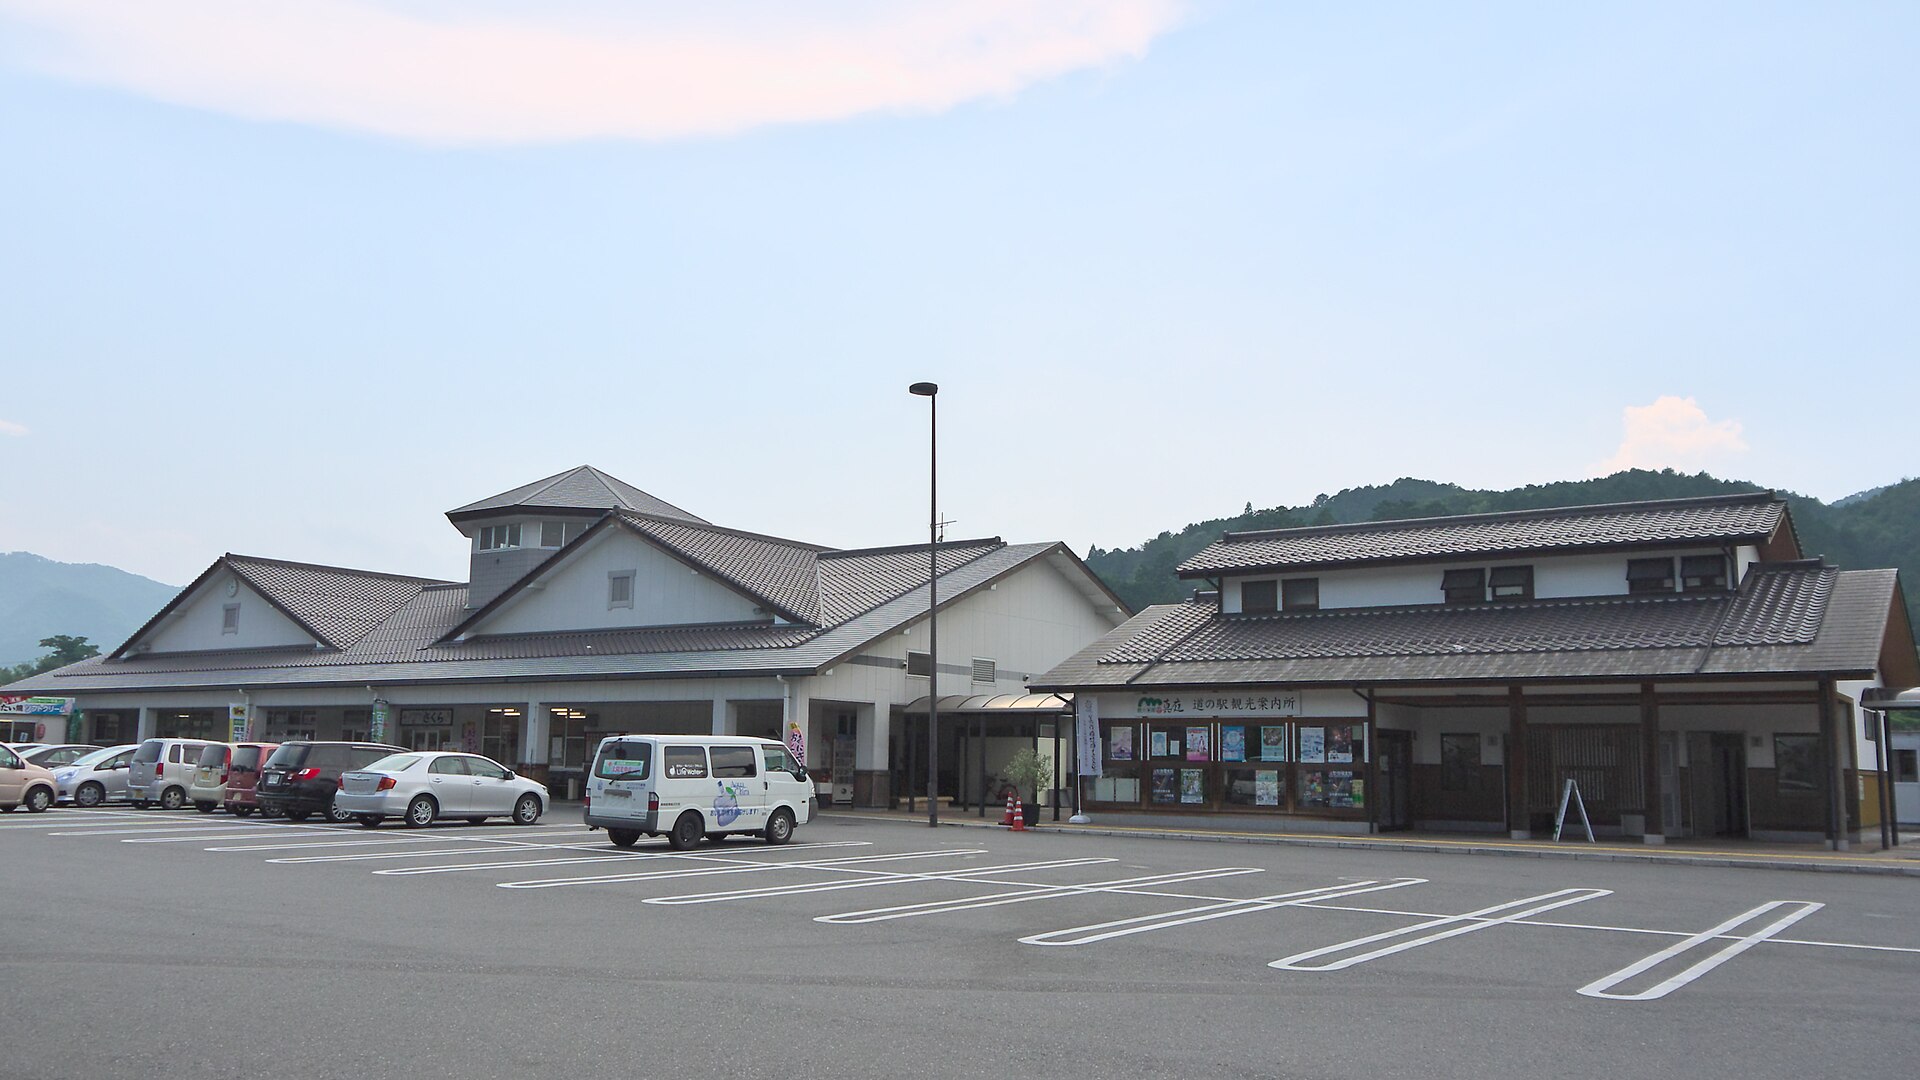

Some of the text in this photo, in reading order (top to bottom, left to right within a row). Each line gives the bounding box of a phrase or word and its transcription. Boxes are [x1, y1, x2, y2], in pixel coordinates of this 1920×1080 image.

[1192, 697, 1295, 711] 道の駅観光案内所
